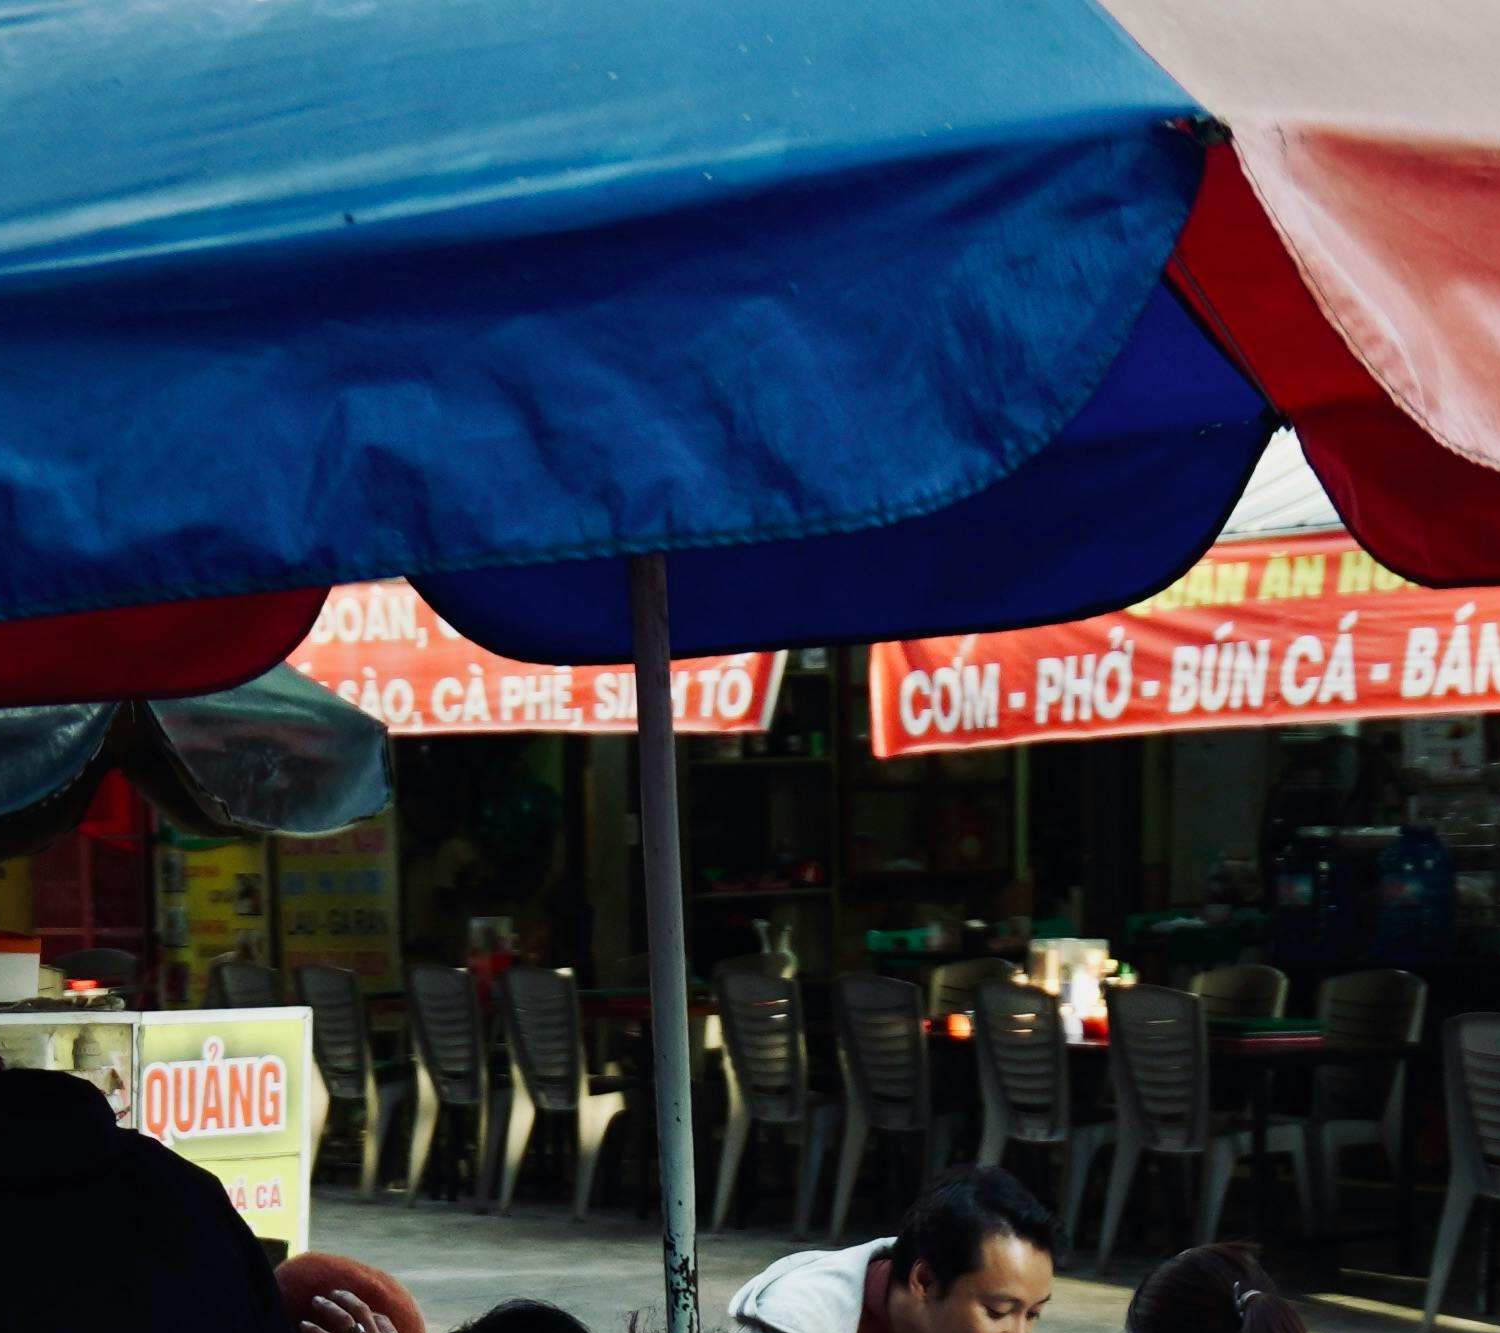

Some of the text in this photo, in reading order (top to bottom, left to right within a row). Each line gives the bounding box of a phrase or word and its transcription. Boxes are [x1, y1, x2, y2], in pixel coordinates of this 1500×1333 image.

[432, 663, 492, 723] CÀ
[501, 665, 583, 730] PHÊ,
[594, 672, 689, 720] SIH
[1167, 621, 1271, 713] BÚN
[1280, 610, 1359, 706] CÁ
[145, 1042, 282, 1142] QUẢNG
